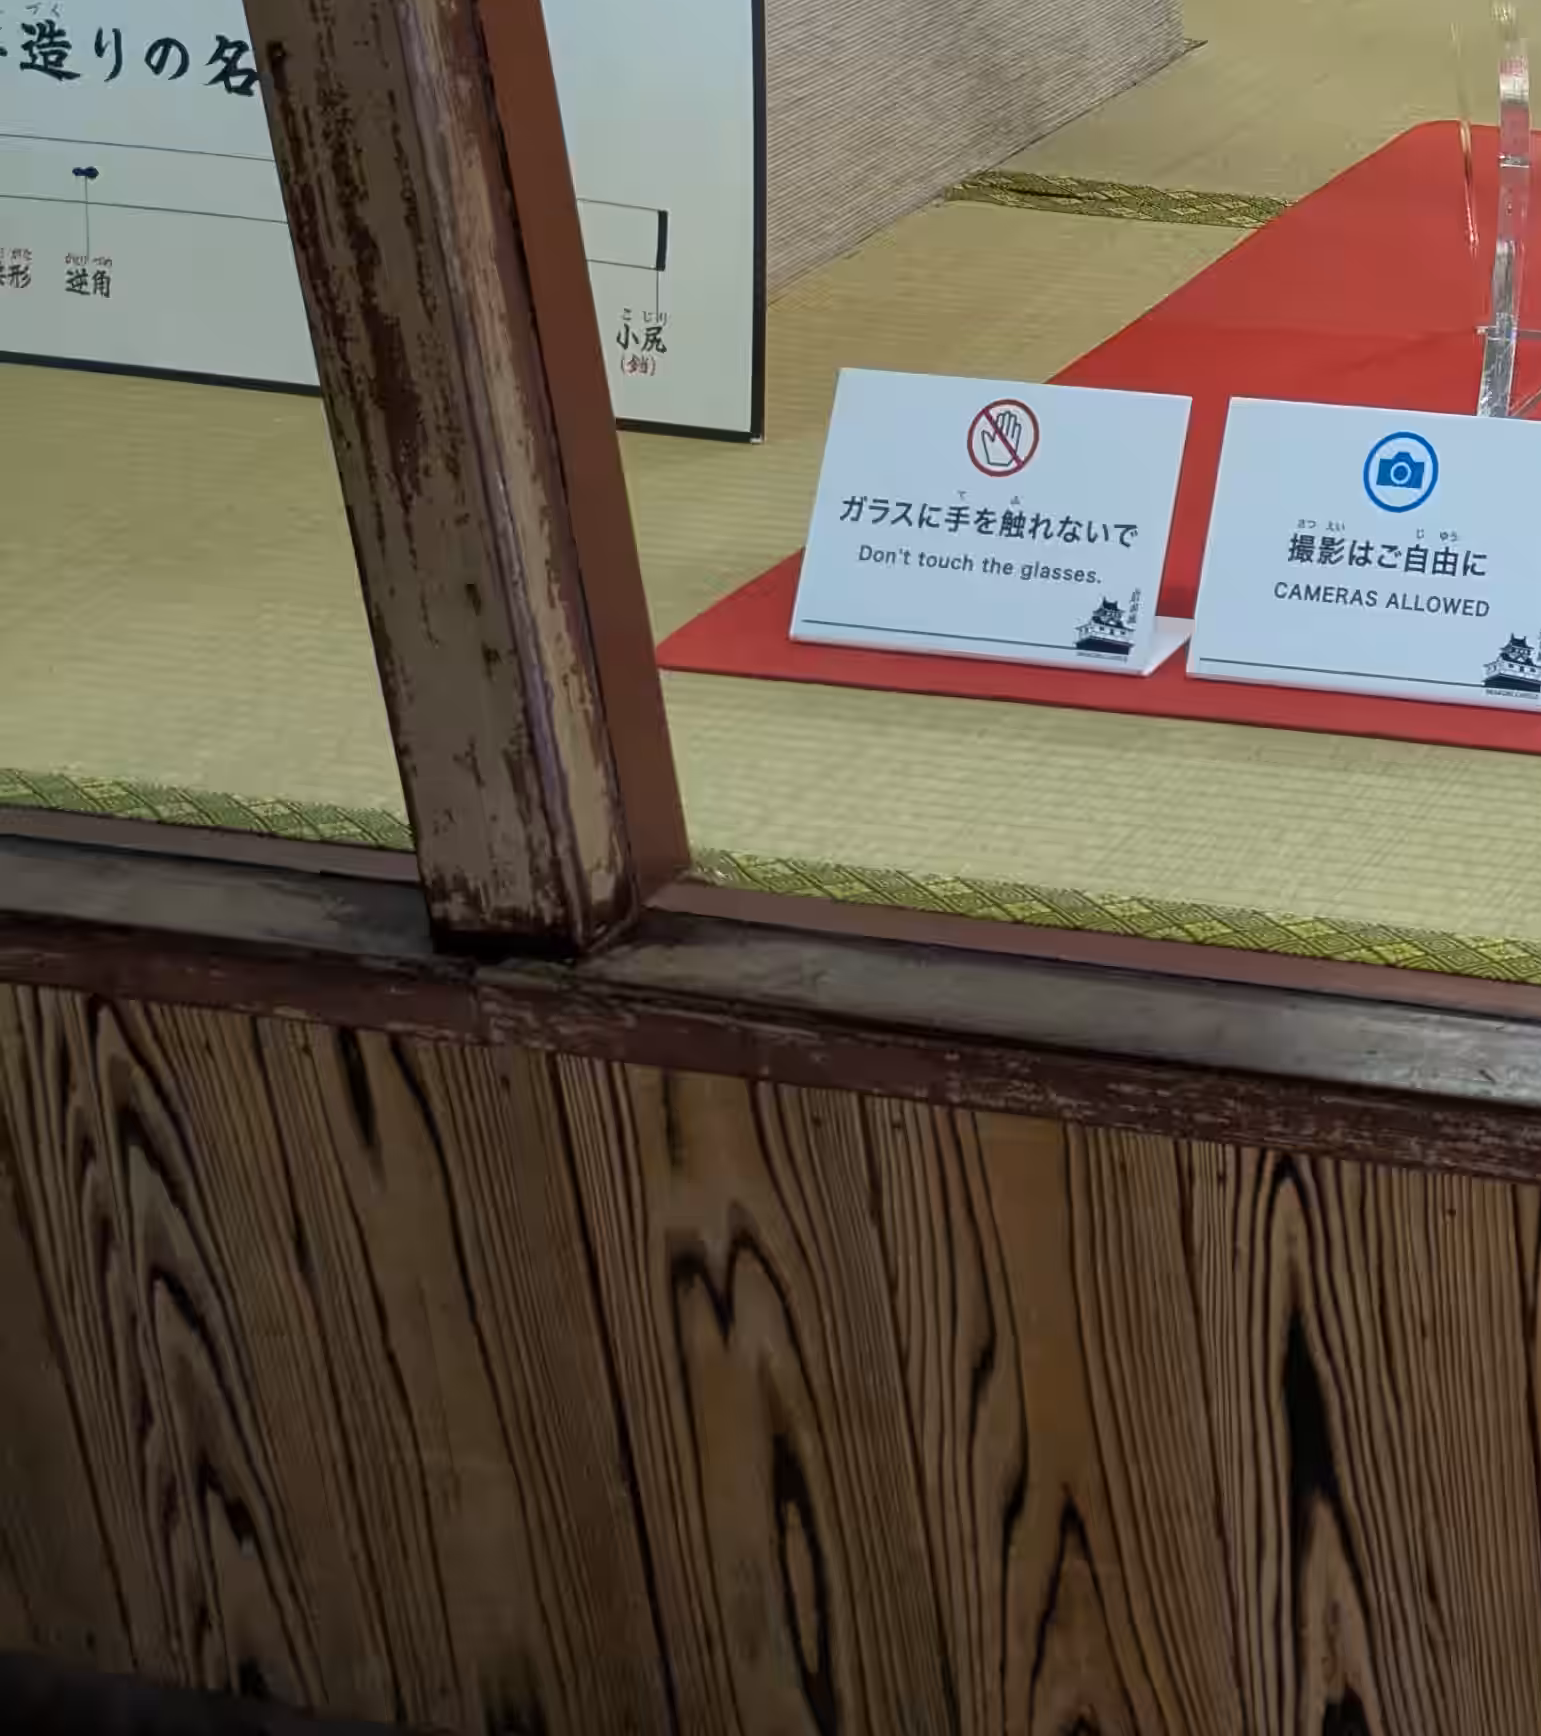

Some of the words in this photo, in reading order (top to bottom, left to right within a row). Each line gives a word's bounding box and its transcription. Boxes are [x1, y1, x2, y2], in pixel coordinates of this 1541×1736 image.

[0, 19, 259, 98] 造りの名
[615, 322, 668, 354] 小尻
[839, 495, 1139, 549] ガラスに手を触れないで
[858, 544, 912, 566] Don't
[917, 551, 974, 572] touch
[981, 556, 1014, 576] the
[1019, 560, 1102, 585] glasses.
[1287, 532, 1488, 577] 撮影はご自由に
[1273, 581, 1379, 608] CAMERAS
[1384, 592, 1491, 618] ALLOWED
